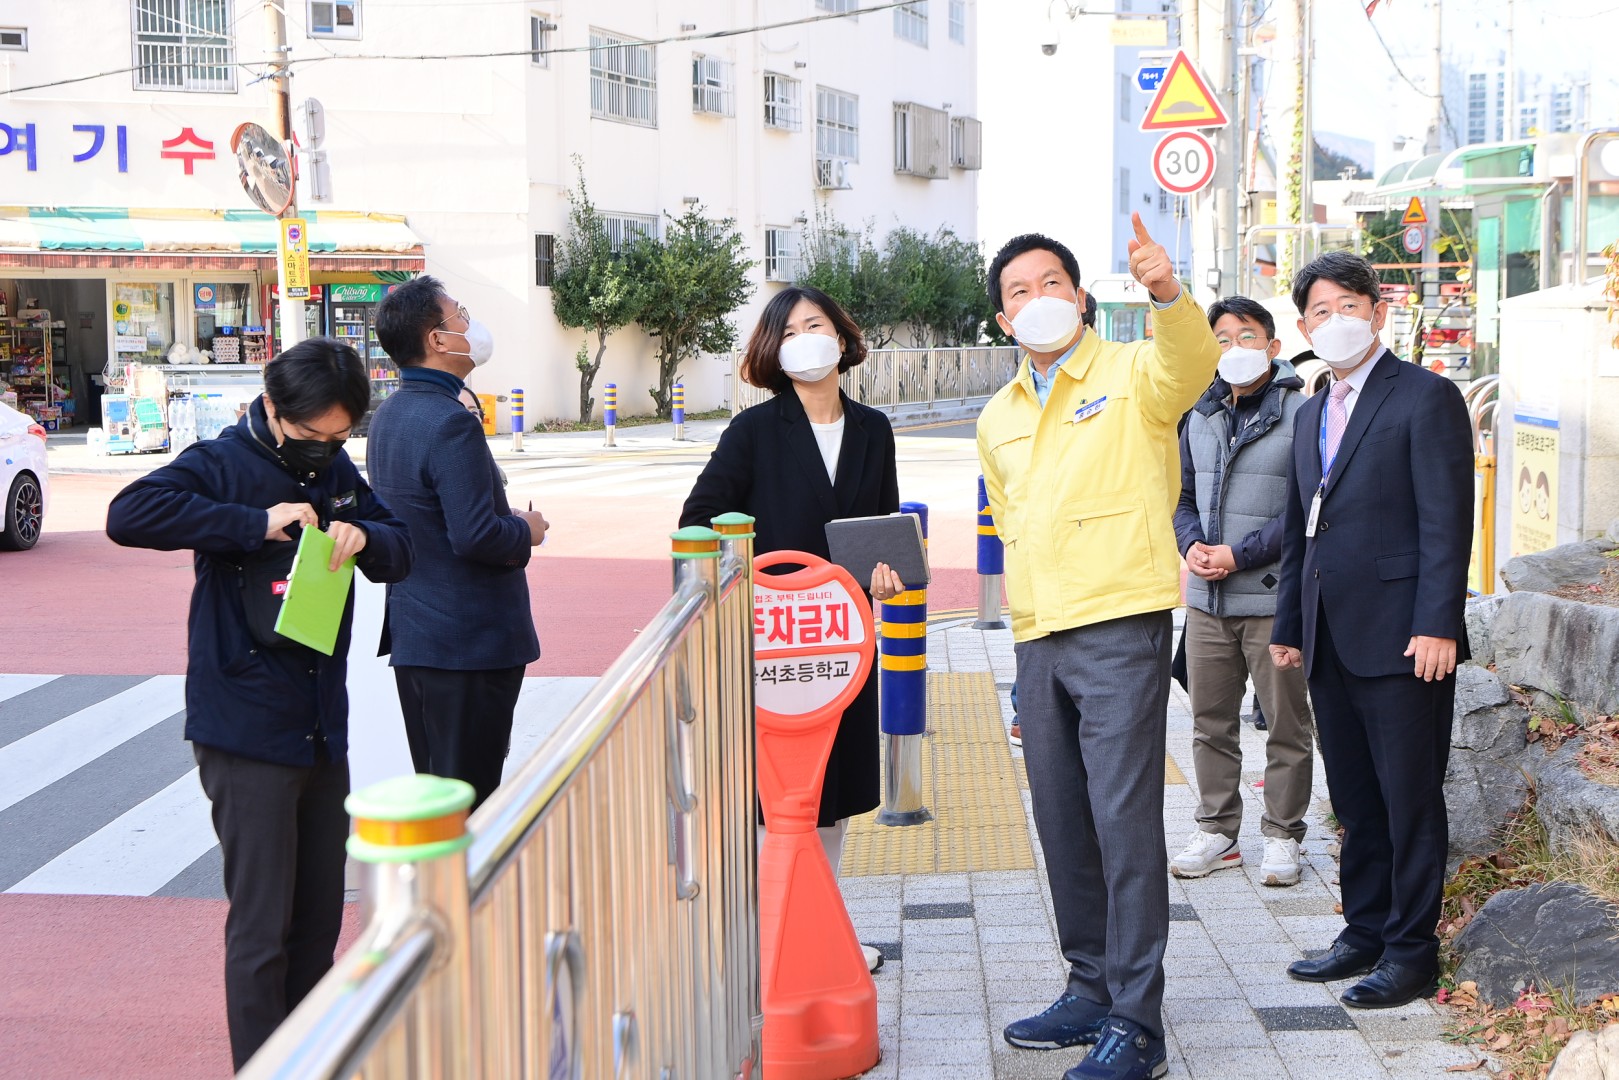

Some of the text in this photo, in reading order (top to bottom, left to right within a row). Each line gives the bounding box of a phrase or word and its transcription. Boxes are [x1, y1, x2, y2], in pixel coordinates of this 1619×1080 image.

[1166, 149, 1200, 175] 30
[1407, 233, 1420, 245] 30
[287, 254, 298, 286] 스마트폰
[335, 284, 368, 299] Chilsung
[276, 583, 287, 592] Di
[777, 593, 794, 602] 부탁
[797, 591, 833, 601] 드립니다
[755, 661, 850, 685] 석초등학교
